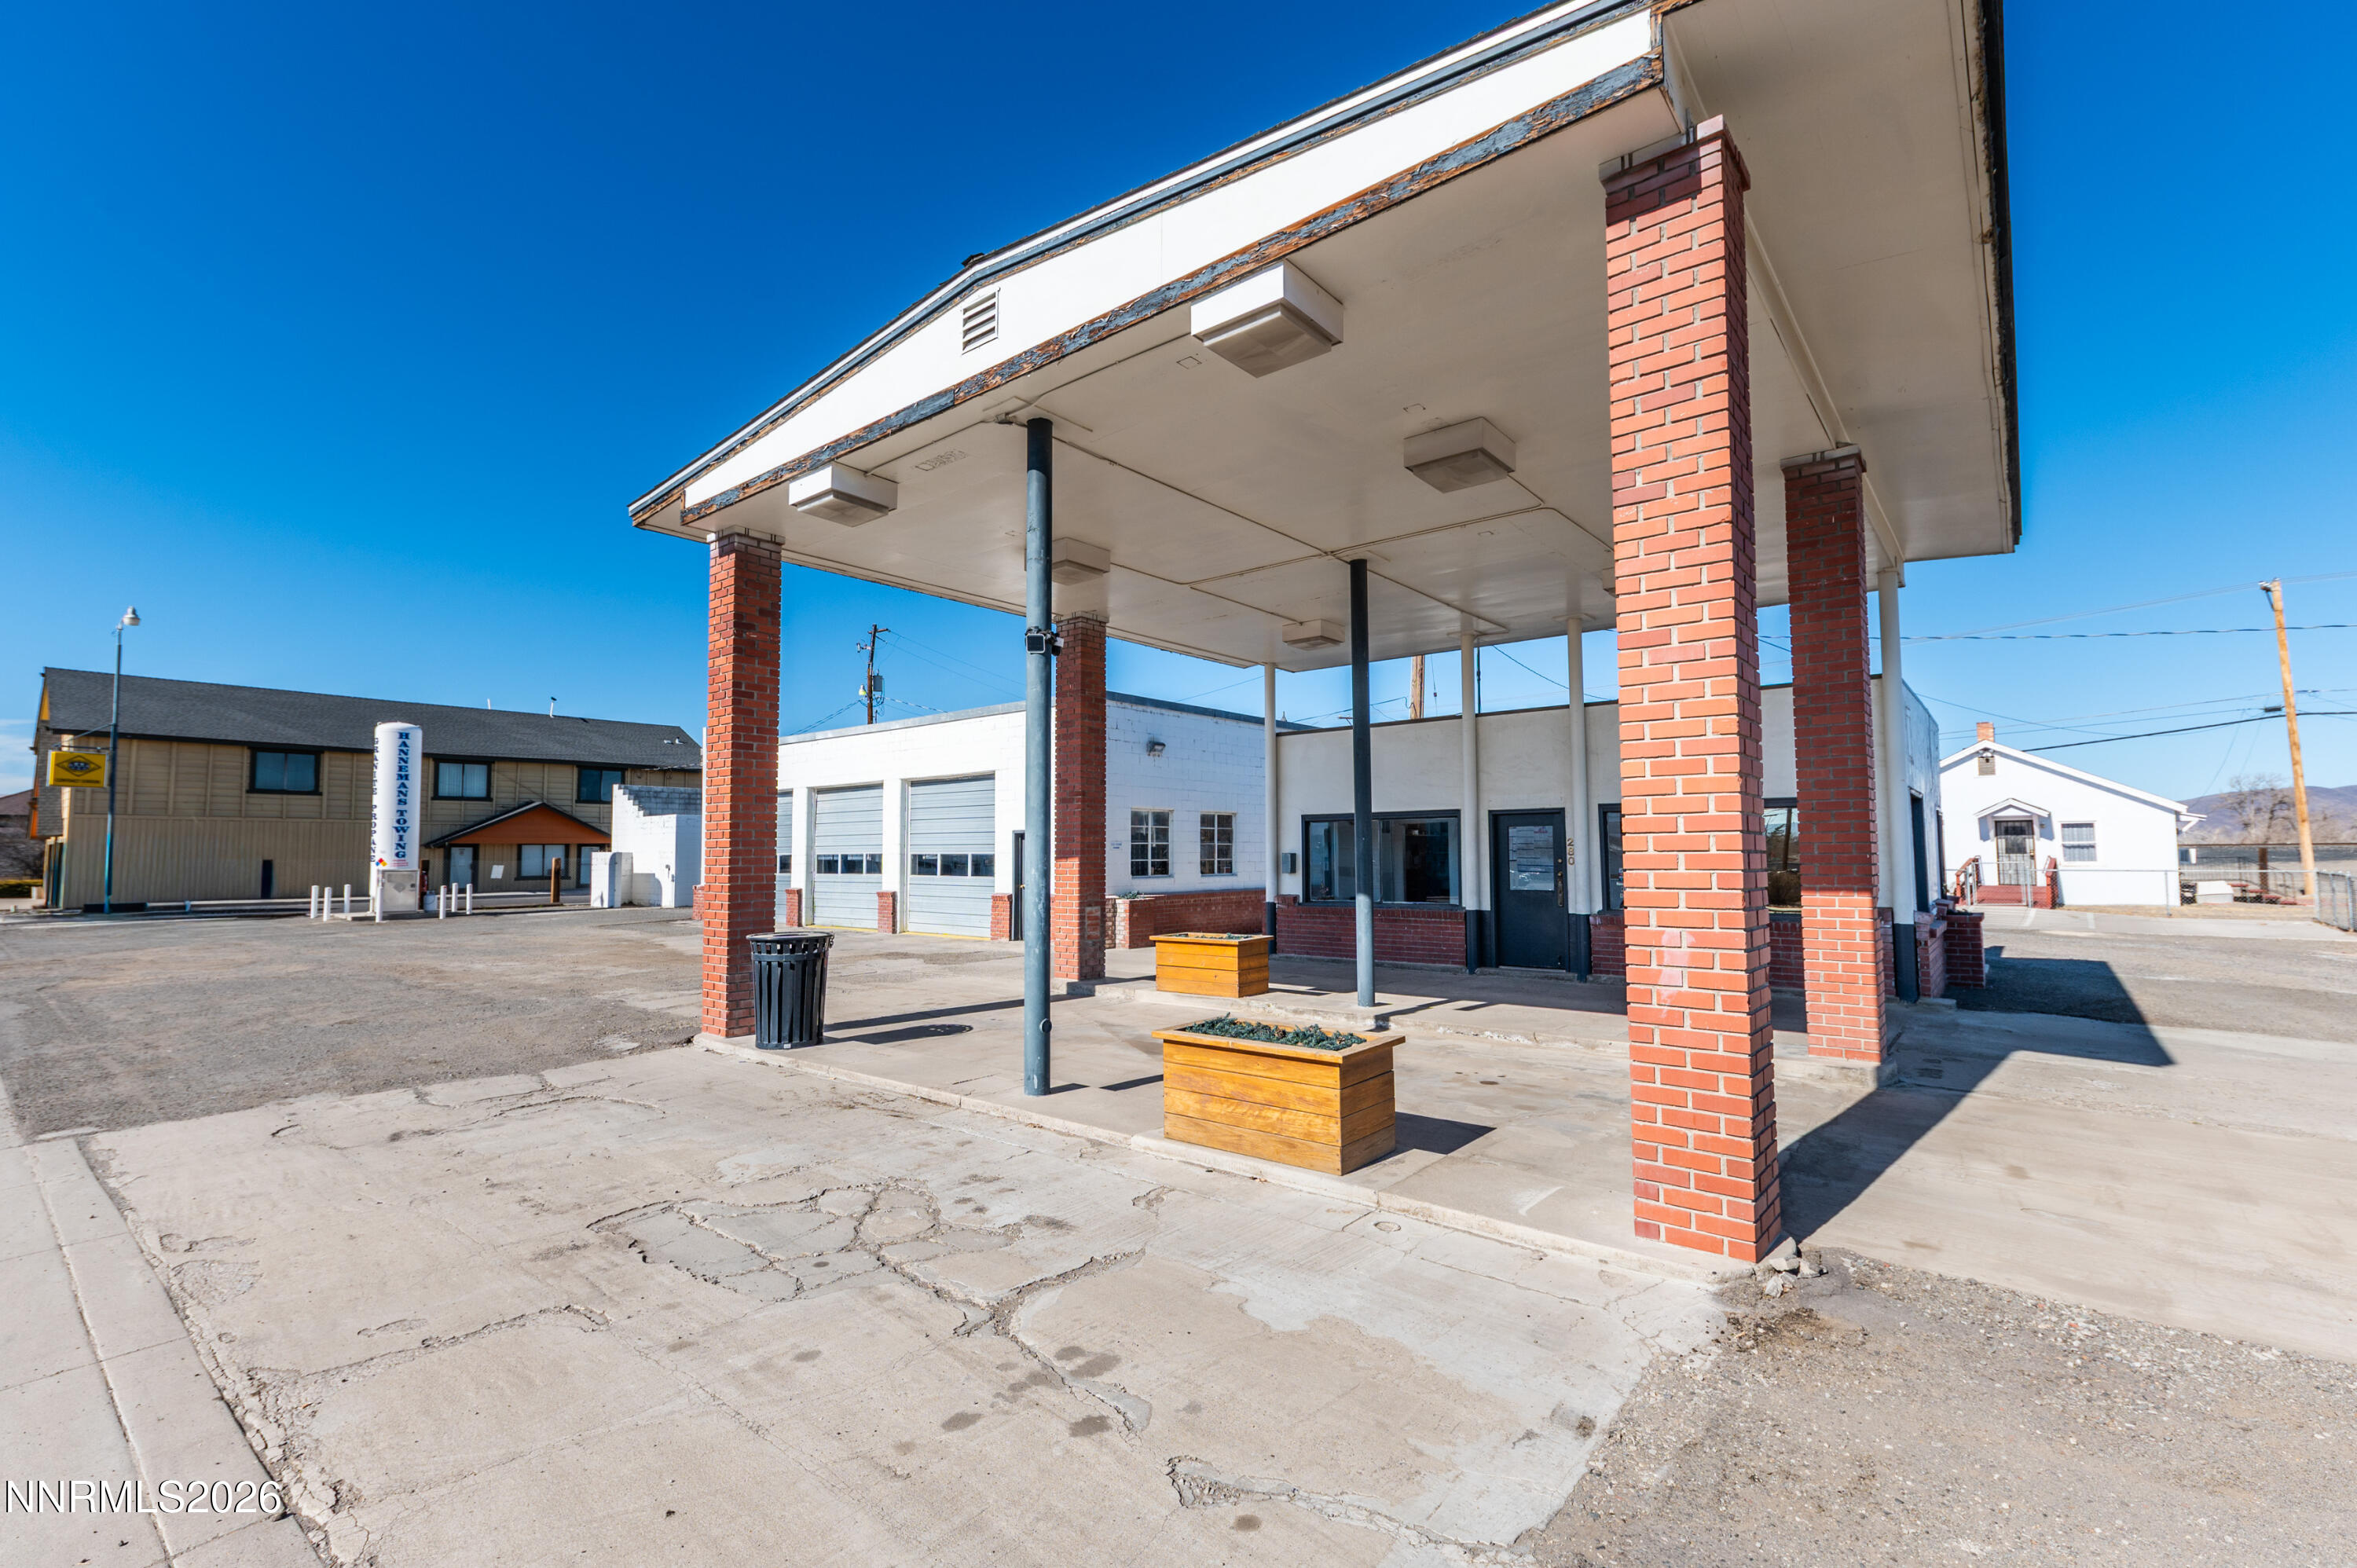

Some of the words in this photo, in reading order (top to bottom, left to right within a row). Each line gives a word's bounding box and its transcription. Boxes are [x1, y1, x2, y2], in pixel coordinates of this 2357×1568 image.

[396, 732, 410, 805] HANNEMANS
[392, 810, 410, 859] TOWING
[1567, 837, 1575, 866] 280
